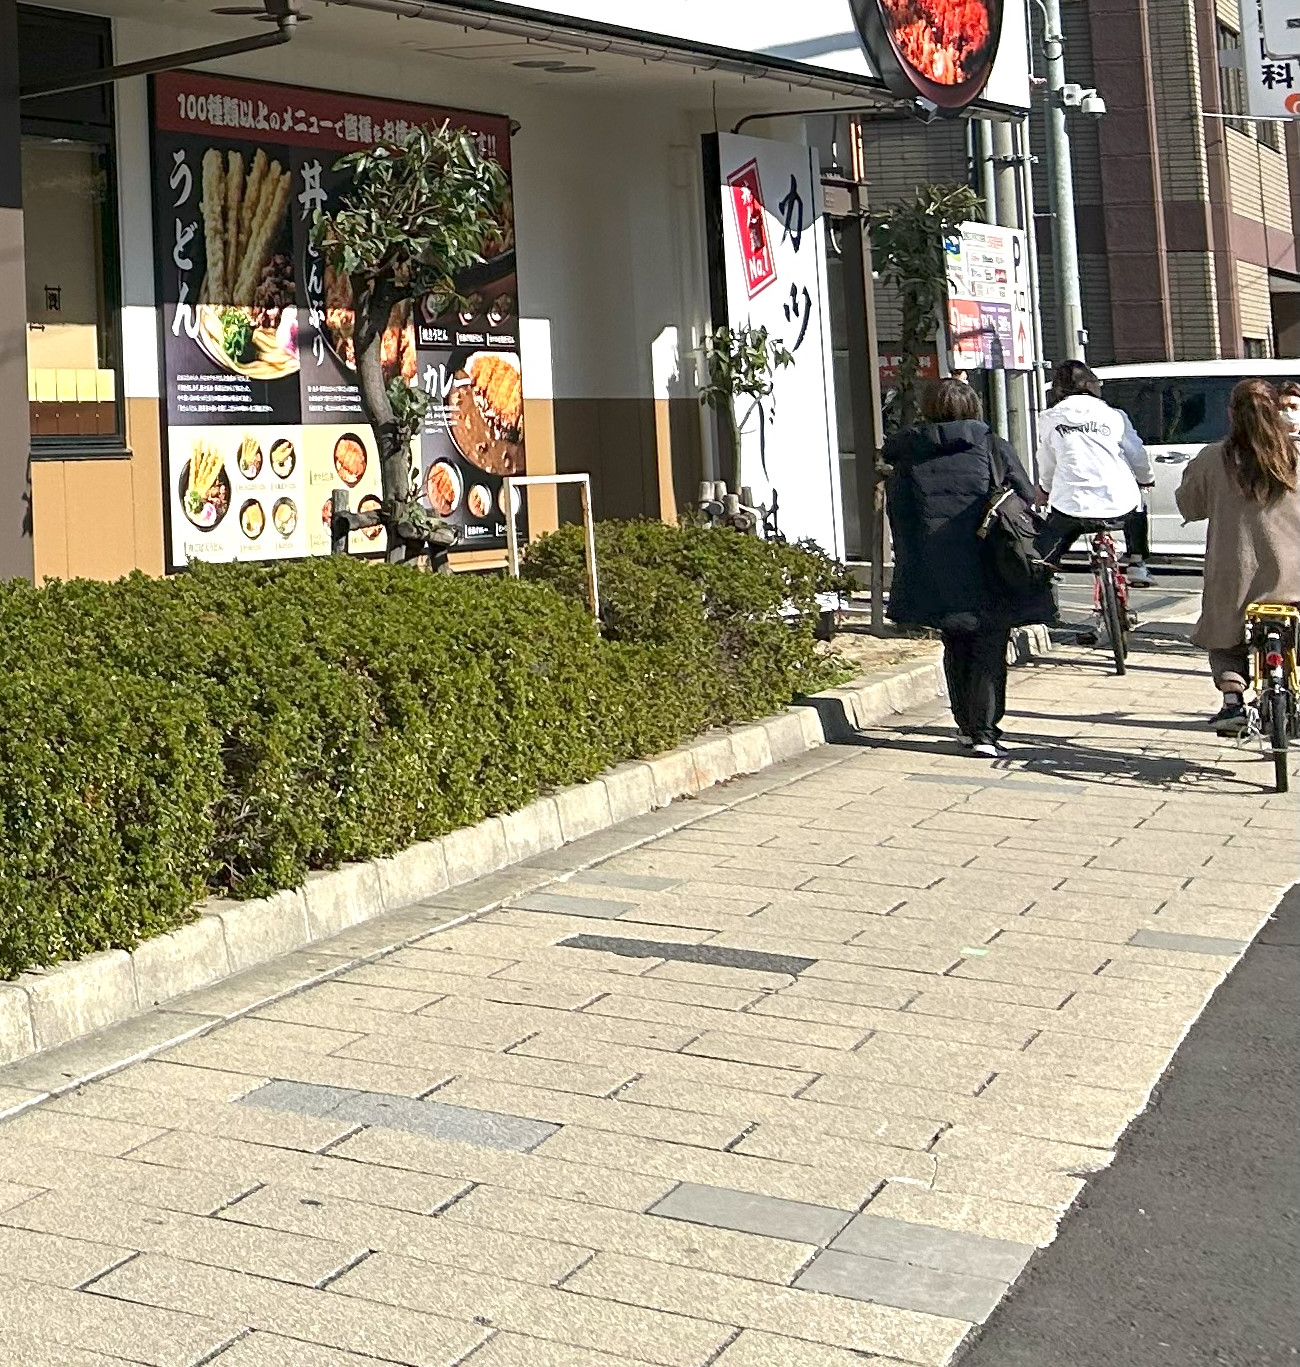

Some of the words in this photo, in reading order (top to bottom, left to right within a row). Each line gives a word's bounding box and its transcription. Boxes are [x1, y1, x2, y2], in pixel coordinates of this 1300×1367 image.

[168, 148, 200, 339] うどん
[423, 363, 472, 399] カレー
